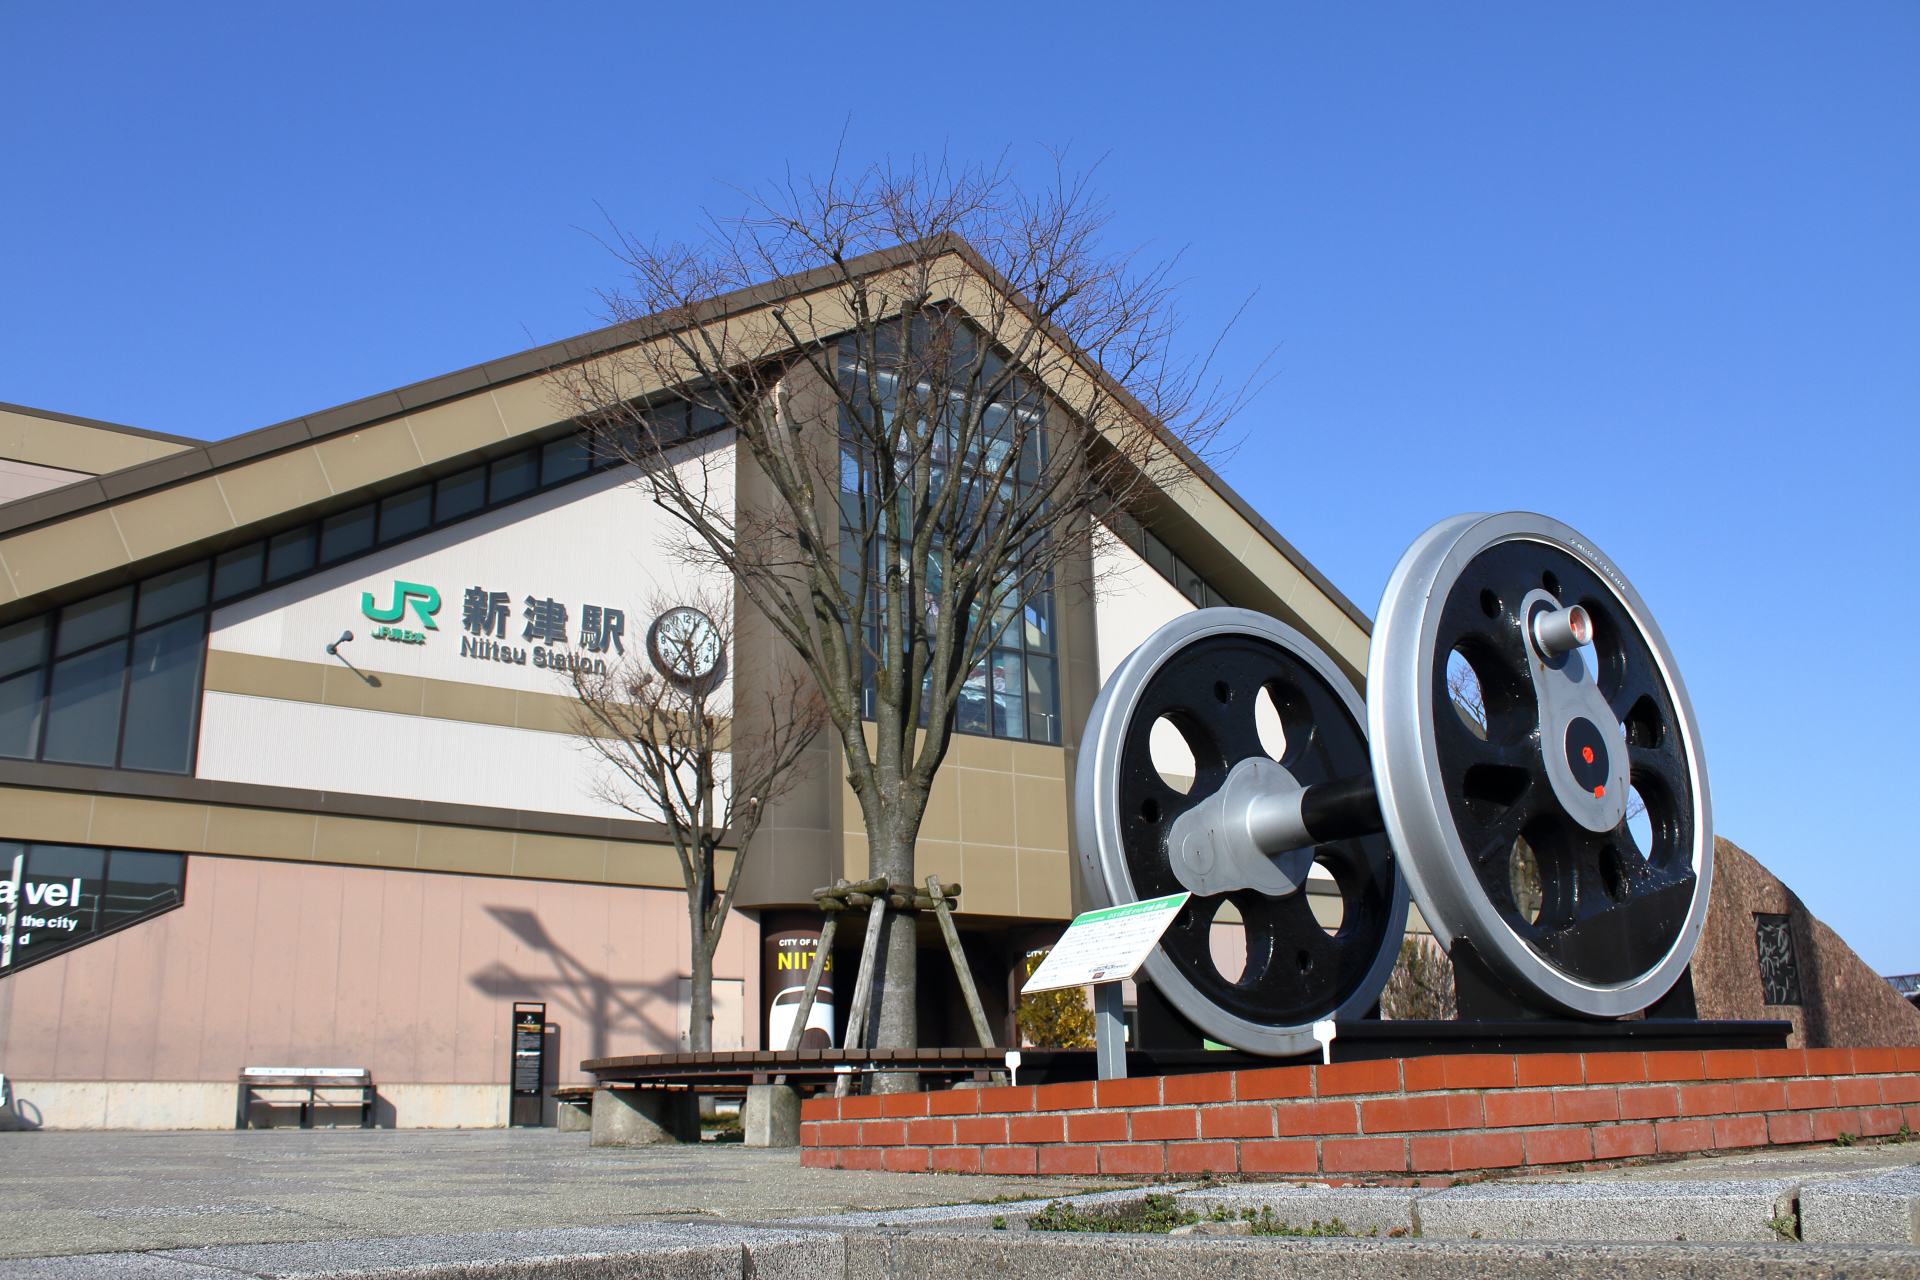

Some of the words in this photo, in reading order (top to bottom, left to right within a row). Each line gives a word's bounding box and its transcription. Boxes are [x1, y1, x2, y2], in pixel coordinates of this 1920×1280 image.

[361, 580, 441, 631] JR
[462, 585, 625, 656] 新津駅
[460, 635, 527, 665] Niitsu
[532, 645, 607, 676] Station
[21, 914, 46, 928] the
[47, 916, 79, 932] city
[779, 939, 798, 947] CITY
